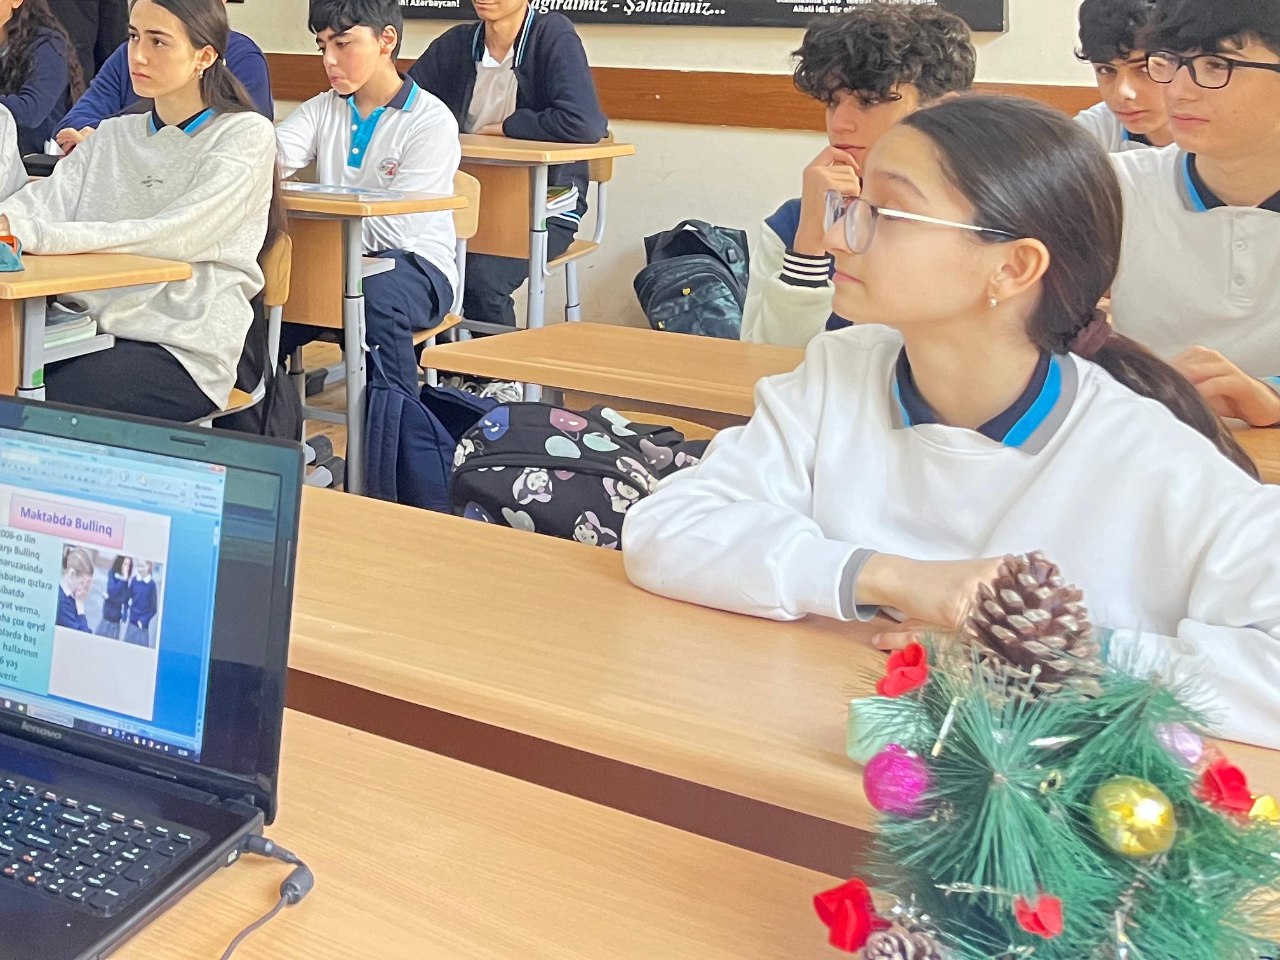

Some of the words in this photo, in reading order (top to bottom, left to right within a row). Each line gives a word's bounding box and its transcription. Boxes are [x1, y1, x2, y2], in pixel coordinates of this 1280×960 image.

[20, 506, 73, 527] Məktəbdə
[75, 518, 112, 538] Bullinq
[22, 720, 62, 740] lenovo
